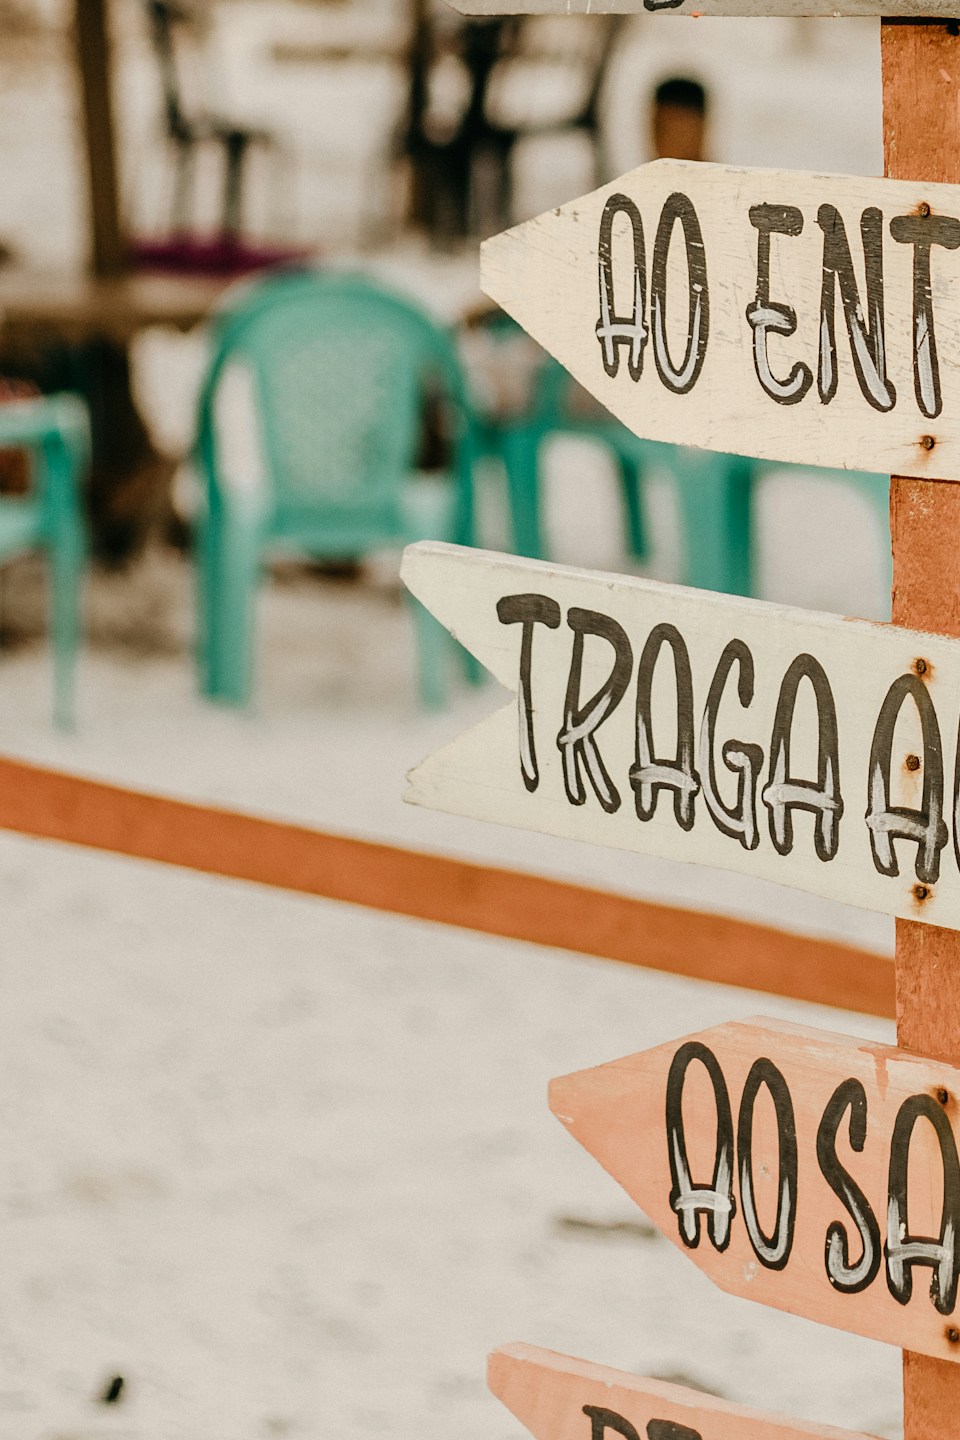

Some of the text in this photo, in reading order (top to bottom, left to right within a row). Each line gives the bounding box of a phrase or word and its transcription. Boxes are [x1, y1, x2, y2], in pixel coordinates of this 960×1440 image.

[596, 192, 709, 395] AO
[495, 593, 844, 863] TRAGA
[665, 1041, 798, 1271] AO
